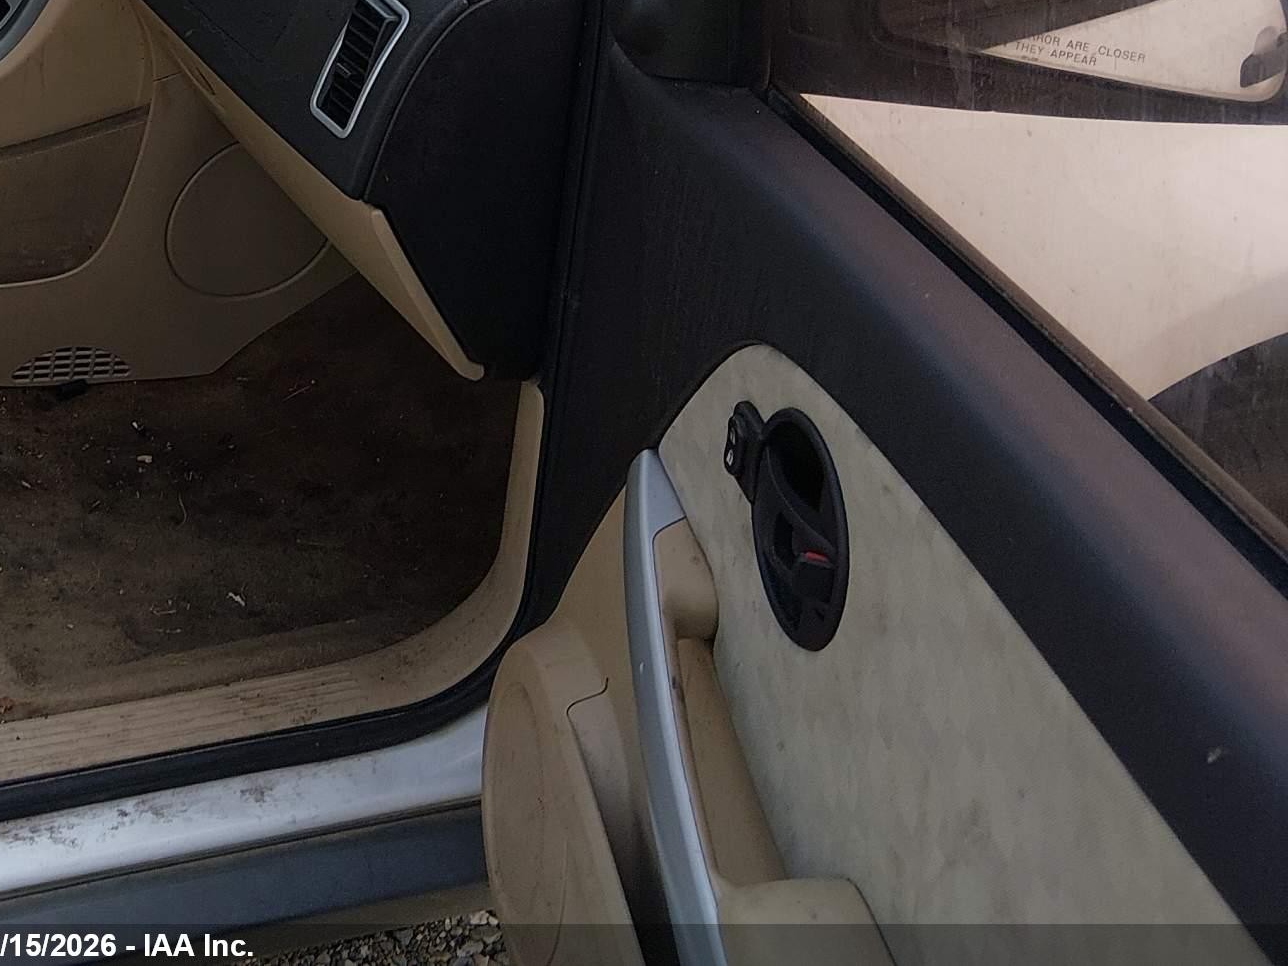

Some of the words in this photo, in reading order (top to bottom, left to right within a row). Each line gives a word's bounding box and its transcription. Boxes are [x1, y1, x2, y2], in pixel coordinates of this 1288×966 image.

[1014, 41, 1045, 54] THEY
[1049, 49, 1097, 66] APPEAR
[1065, 39, 1091, 52] ARE
[1097, 45, 1146, 63] CLOSER
